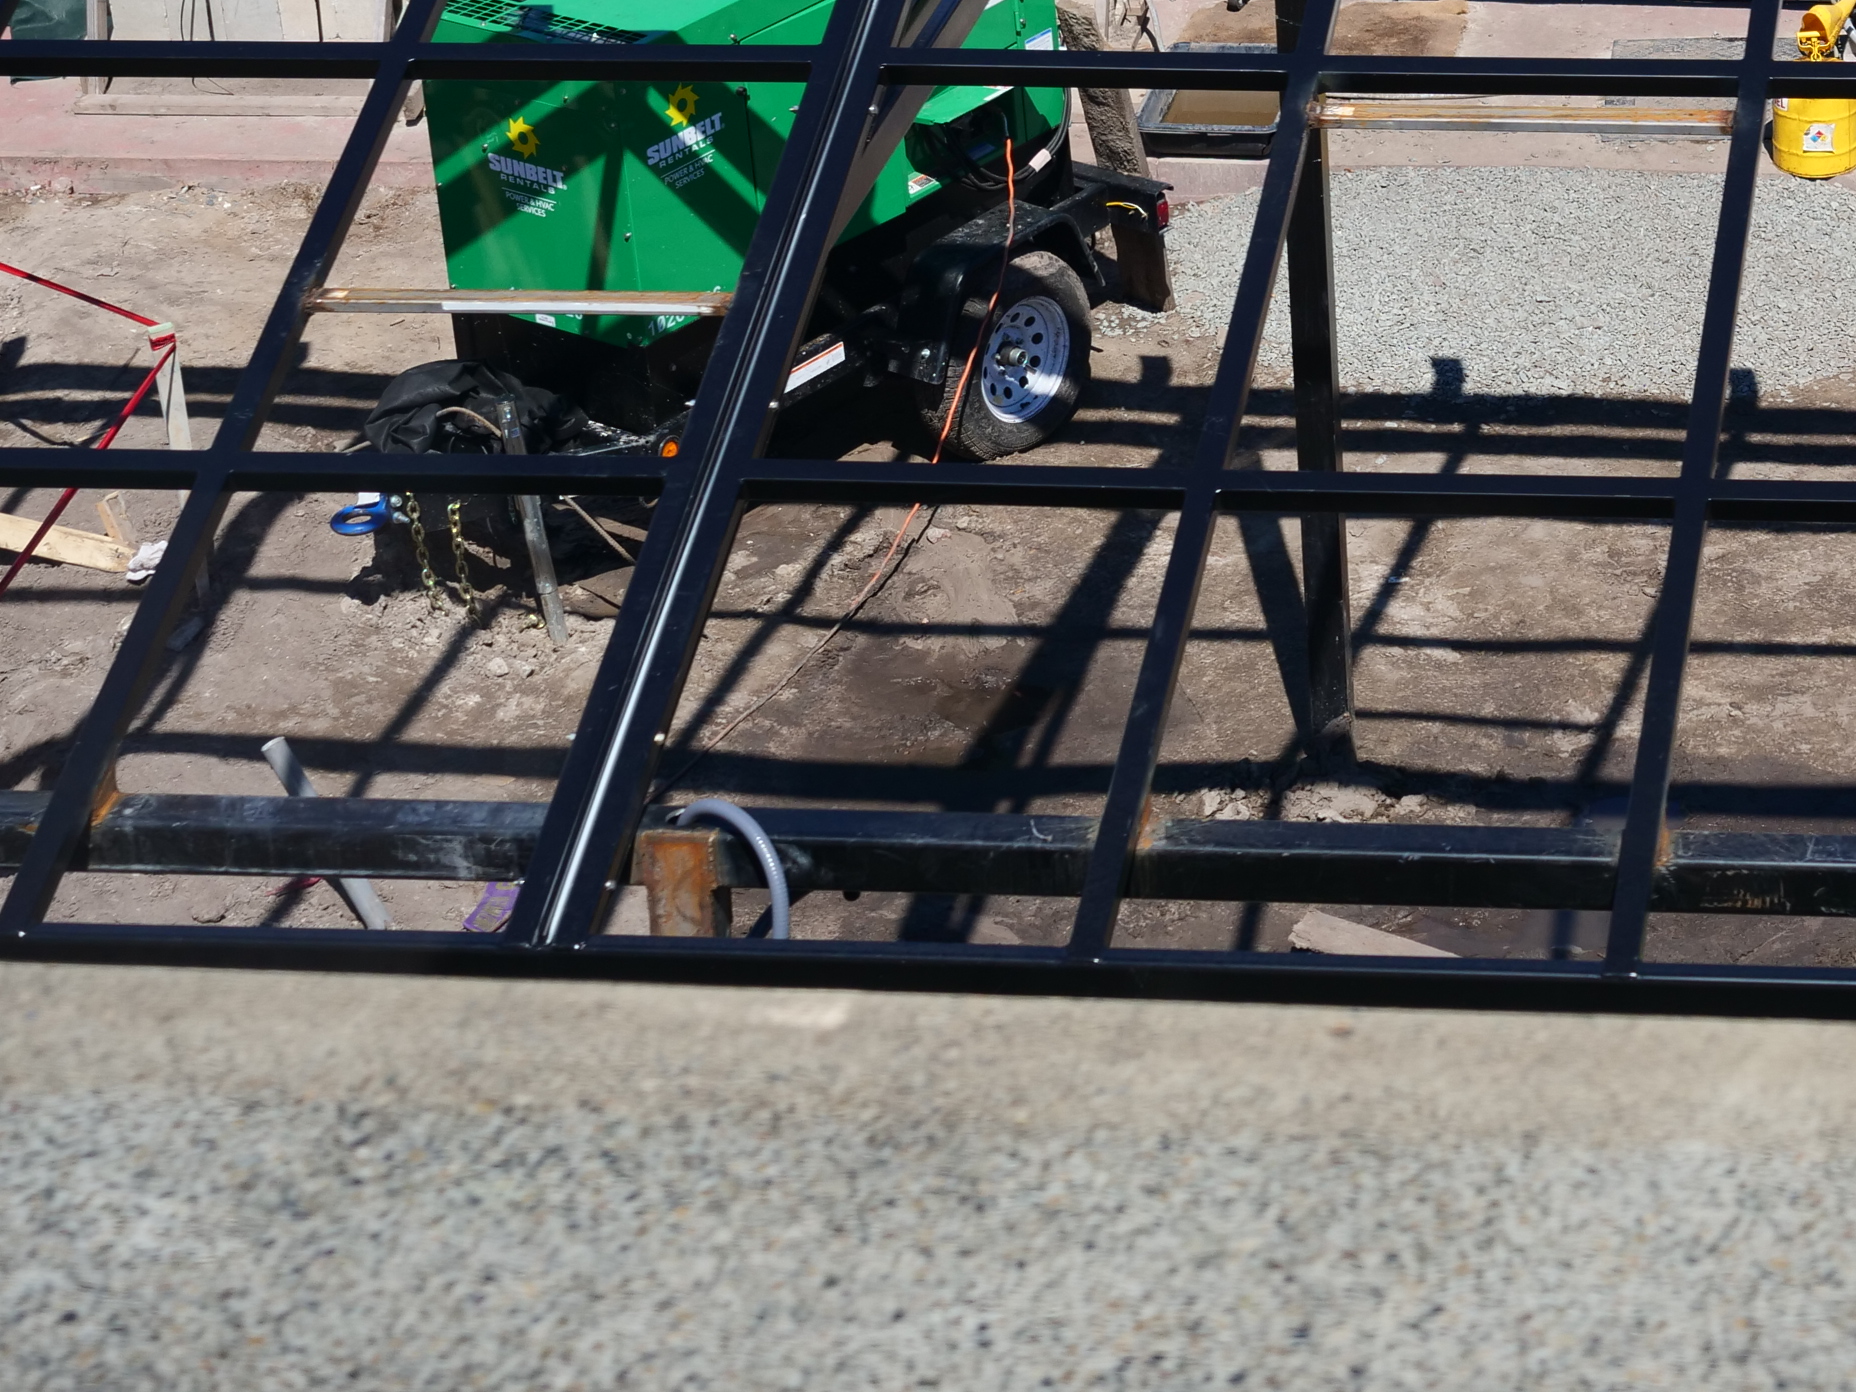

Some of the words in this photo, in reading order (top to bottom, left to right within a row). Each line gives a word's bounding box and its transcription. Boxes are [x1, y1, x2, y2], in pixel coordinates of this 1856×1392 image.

[647, 112, 722, 166] SUNBELT
[659, 135, 714, 169] RENTALS
[487, 152, 564, 189] SUNBELT
[664, 168, 688, 185] POWER
[500, 173, 556, 195] RENTALS
[505, 191, 529, 204] POWER
[516, 202, 547, 218] SERVICES
